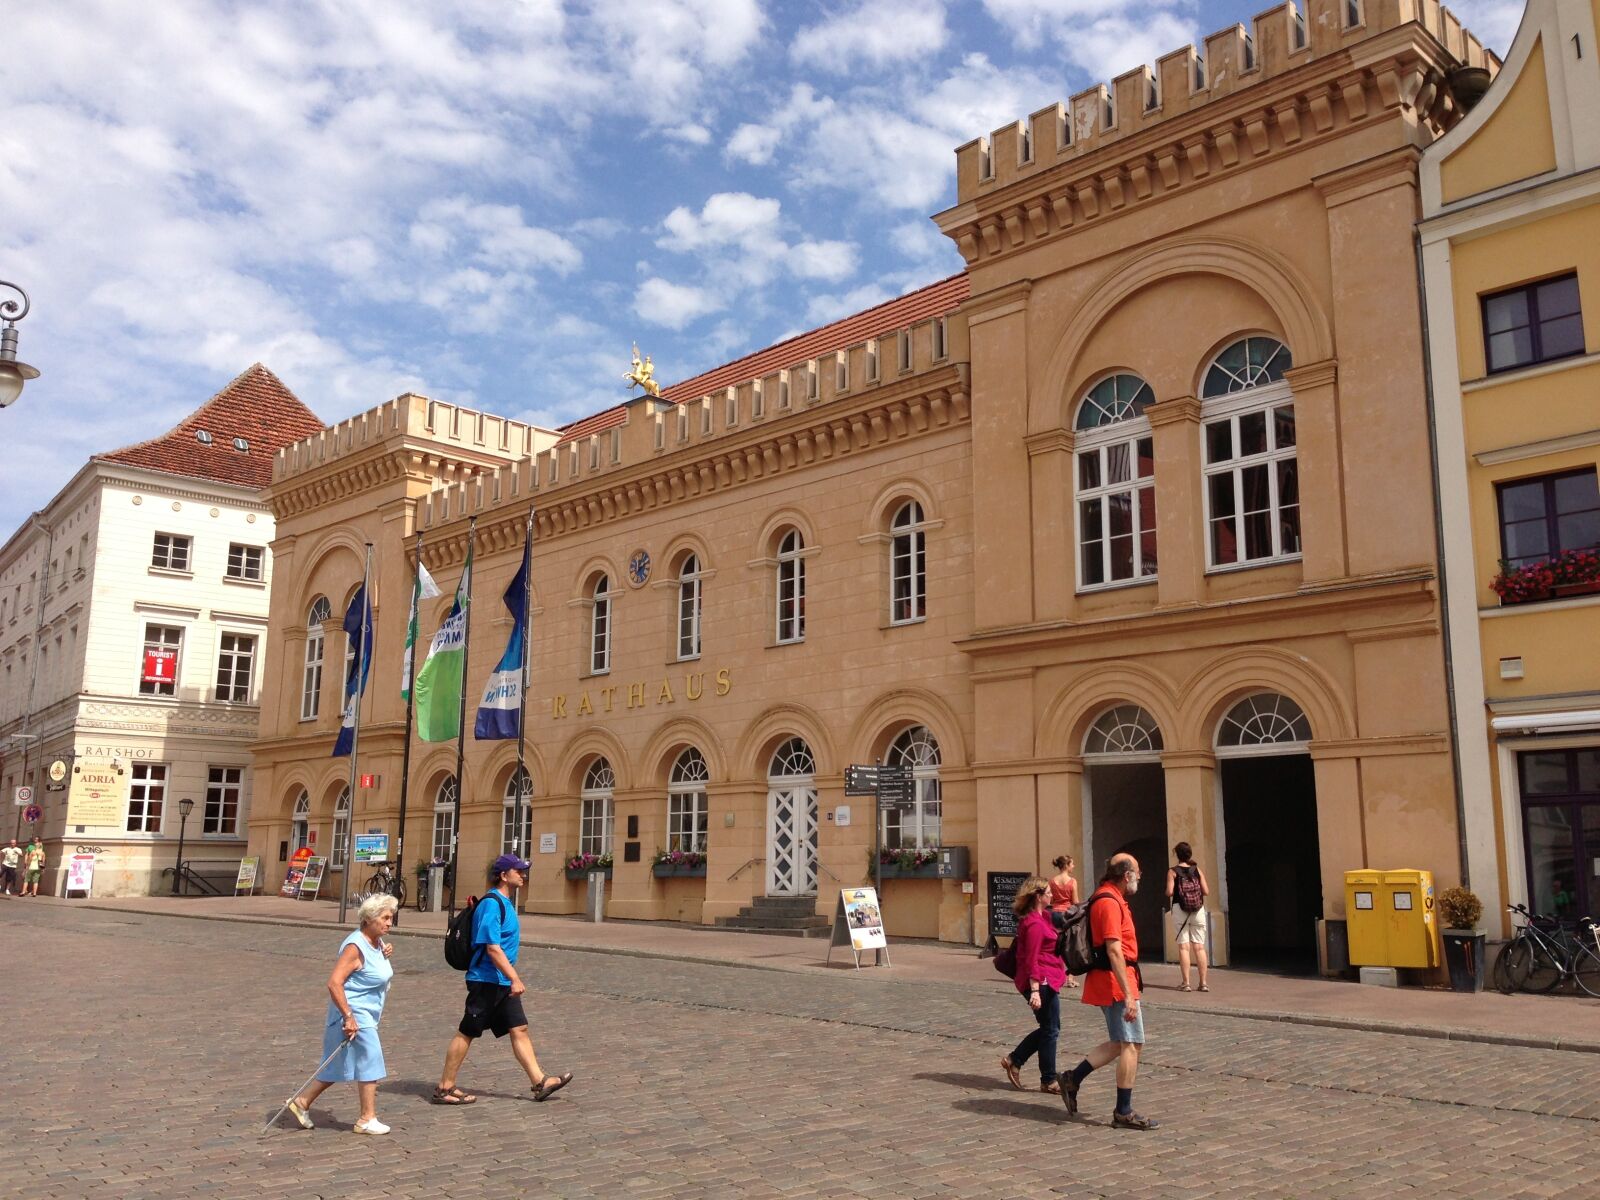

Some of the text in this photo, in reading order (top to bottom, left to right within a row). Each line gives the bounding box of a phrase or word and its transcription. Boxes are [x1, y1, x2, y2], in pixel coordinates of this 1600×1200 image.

[148, 650, 175, 659] TOURIST
[552, 668, 732, 720] RATHAUS
[85, 746, 154, 758] RATSHOF
[80, 774, 116, 784] ADRIA
